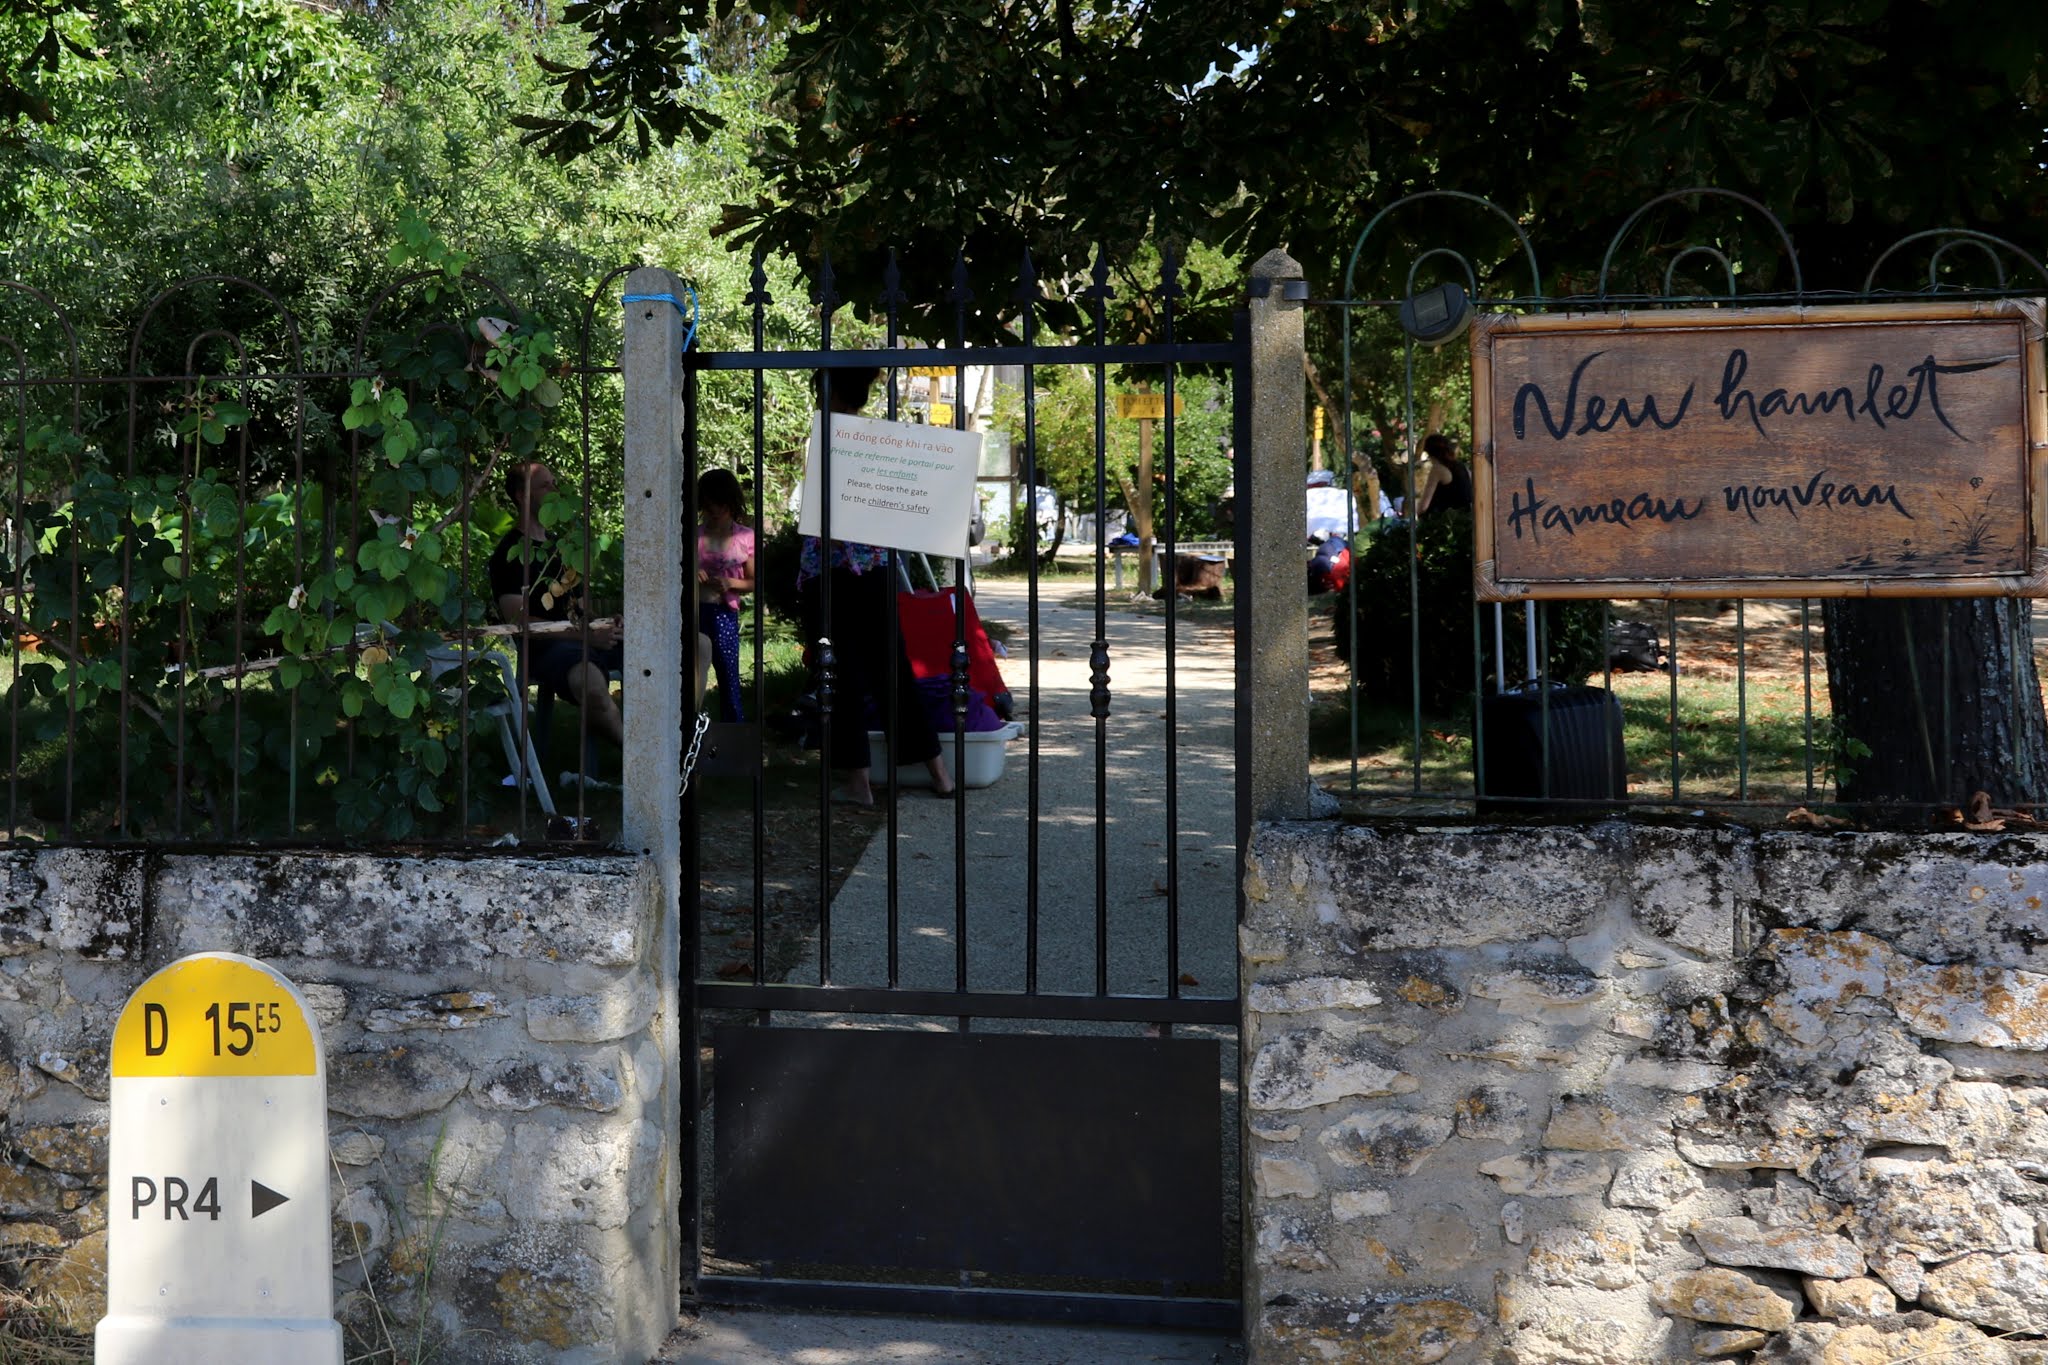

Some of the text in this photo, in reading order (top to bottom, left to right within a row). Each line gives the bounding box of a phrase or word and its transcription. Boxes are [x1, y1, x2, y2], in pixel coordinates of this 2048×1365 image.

[1513, 348, 2014, 442] New hamlet
[835, 429, 850, 440] Xin
[905, 438, 921, 449] khi
[923, 442, 933, 451] ra
[935, 443, 954, 454] vào
[831, 447, 954, 471] Prière de refermer le portail pour
[860, 466, 918, 481] que les enfants
[847, 478, 928, 497] Please, close the gate
[841, 493, 931, 515] for the children's safety
[1508, 469, 1915, 543] Hameau nouveau
[144, 1003, 169, 1057] D
[132, 1177, 222, 1221] PR4
